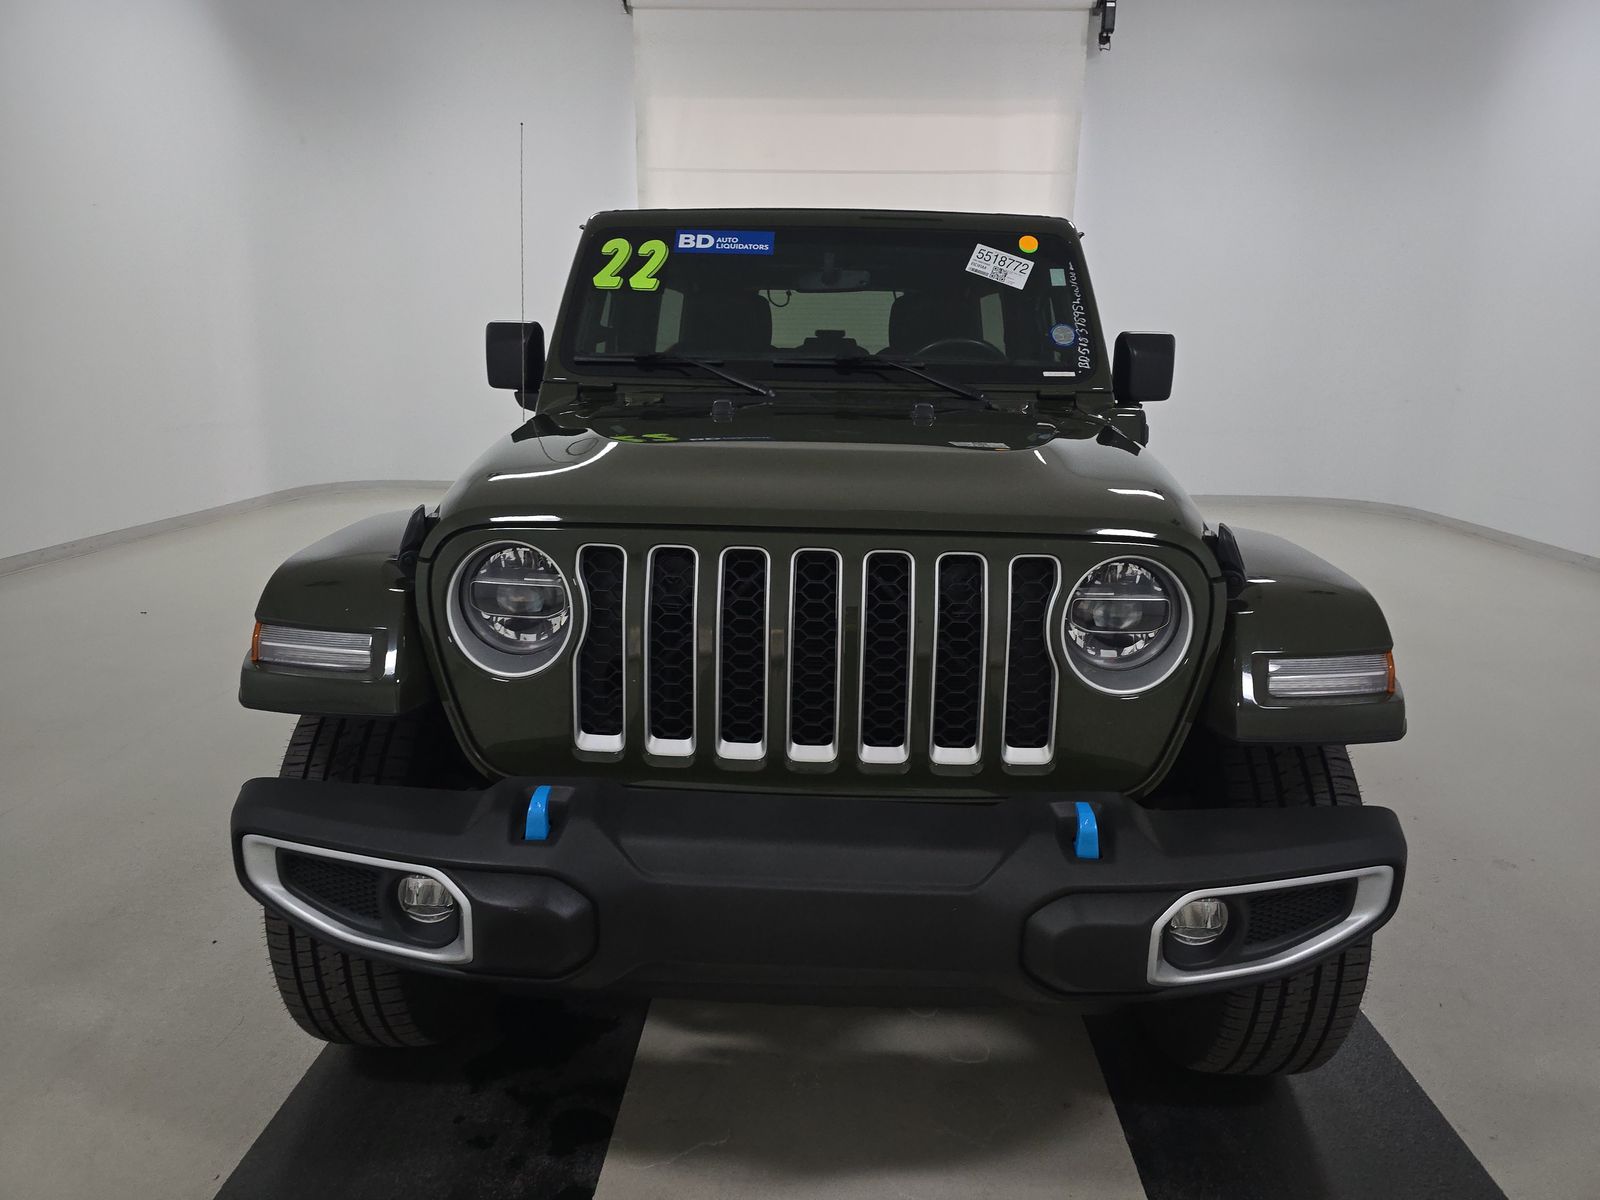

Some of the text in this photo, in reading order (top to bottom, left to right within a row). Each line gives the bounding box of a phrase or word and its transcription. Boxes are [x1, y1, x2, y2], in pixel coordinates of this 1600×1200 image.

[678, 233, 715, 249] BD
[593, 238, 669, 291] 22
[976, 248, 1030, 275] 5518772
